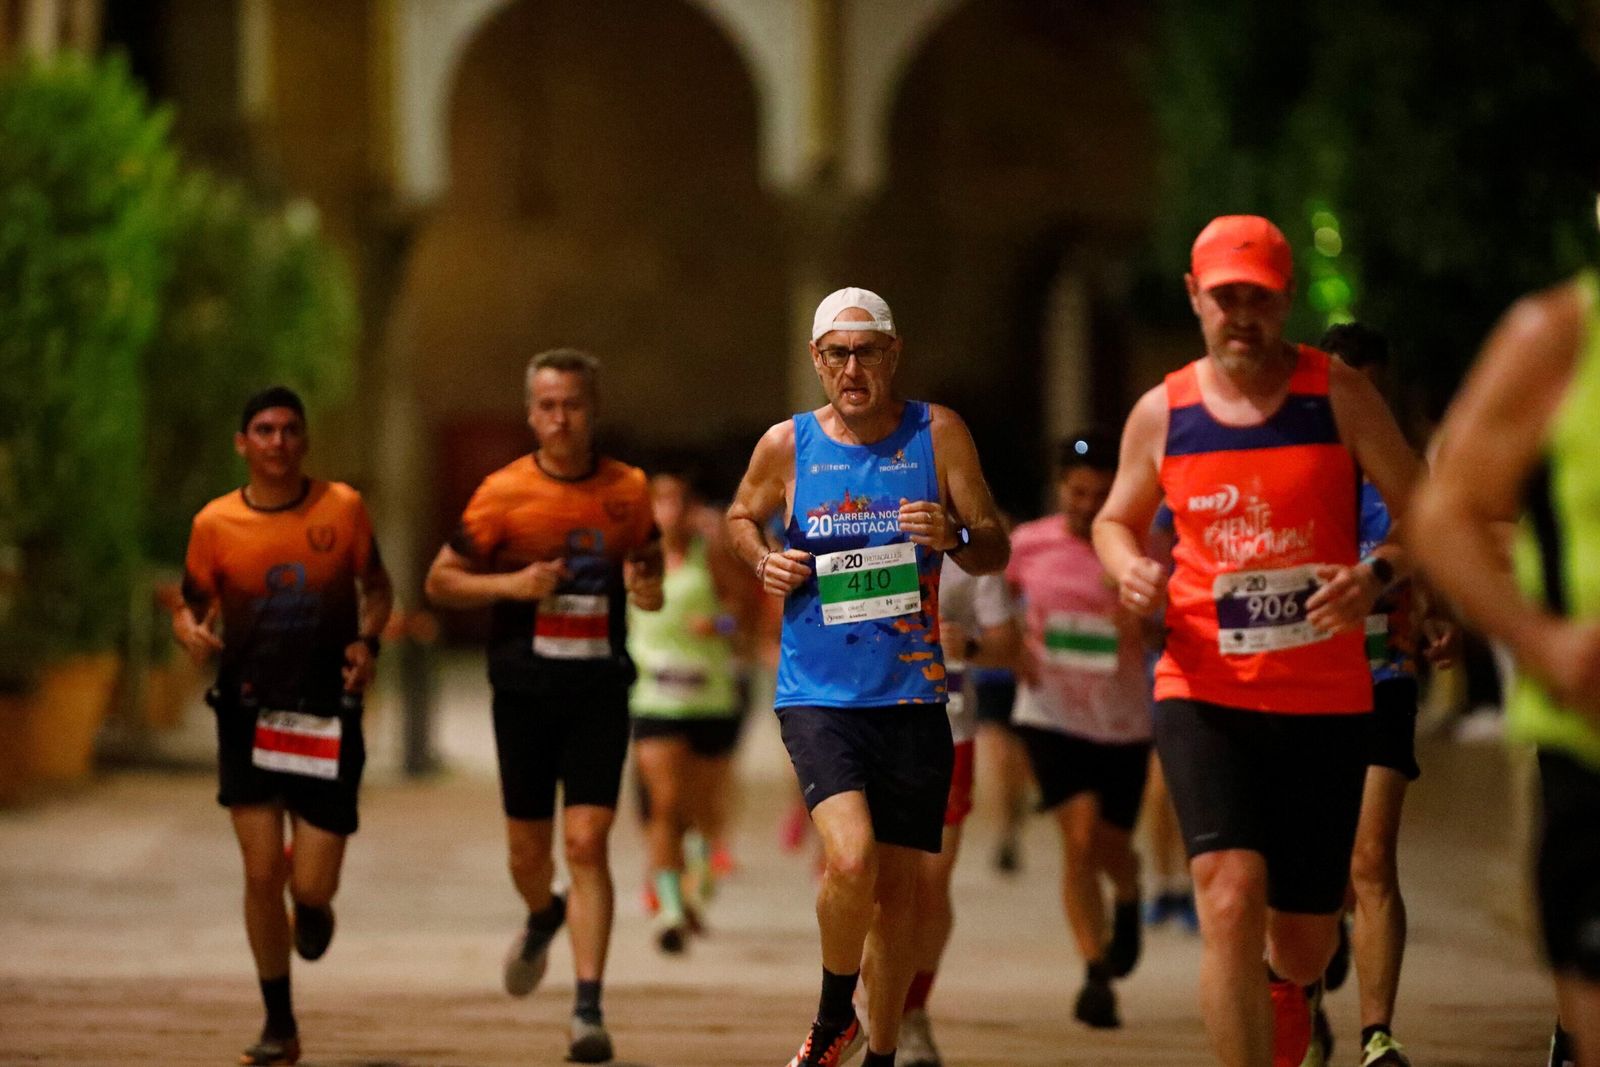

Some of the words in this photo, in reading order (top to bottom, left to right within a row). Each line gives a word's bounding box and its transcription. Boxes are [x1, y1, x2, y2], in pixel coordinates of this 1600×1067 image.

[806, 514, 832, 538] 20
[833, 512, 876, 522] CARRERA
[845, 553, 863, 569] 20
[847, 569, 892, 593] 410
[1245, 574, 1267, 592] 20
[1246, 593, 1298, 621] 906
